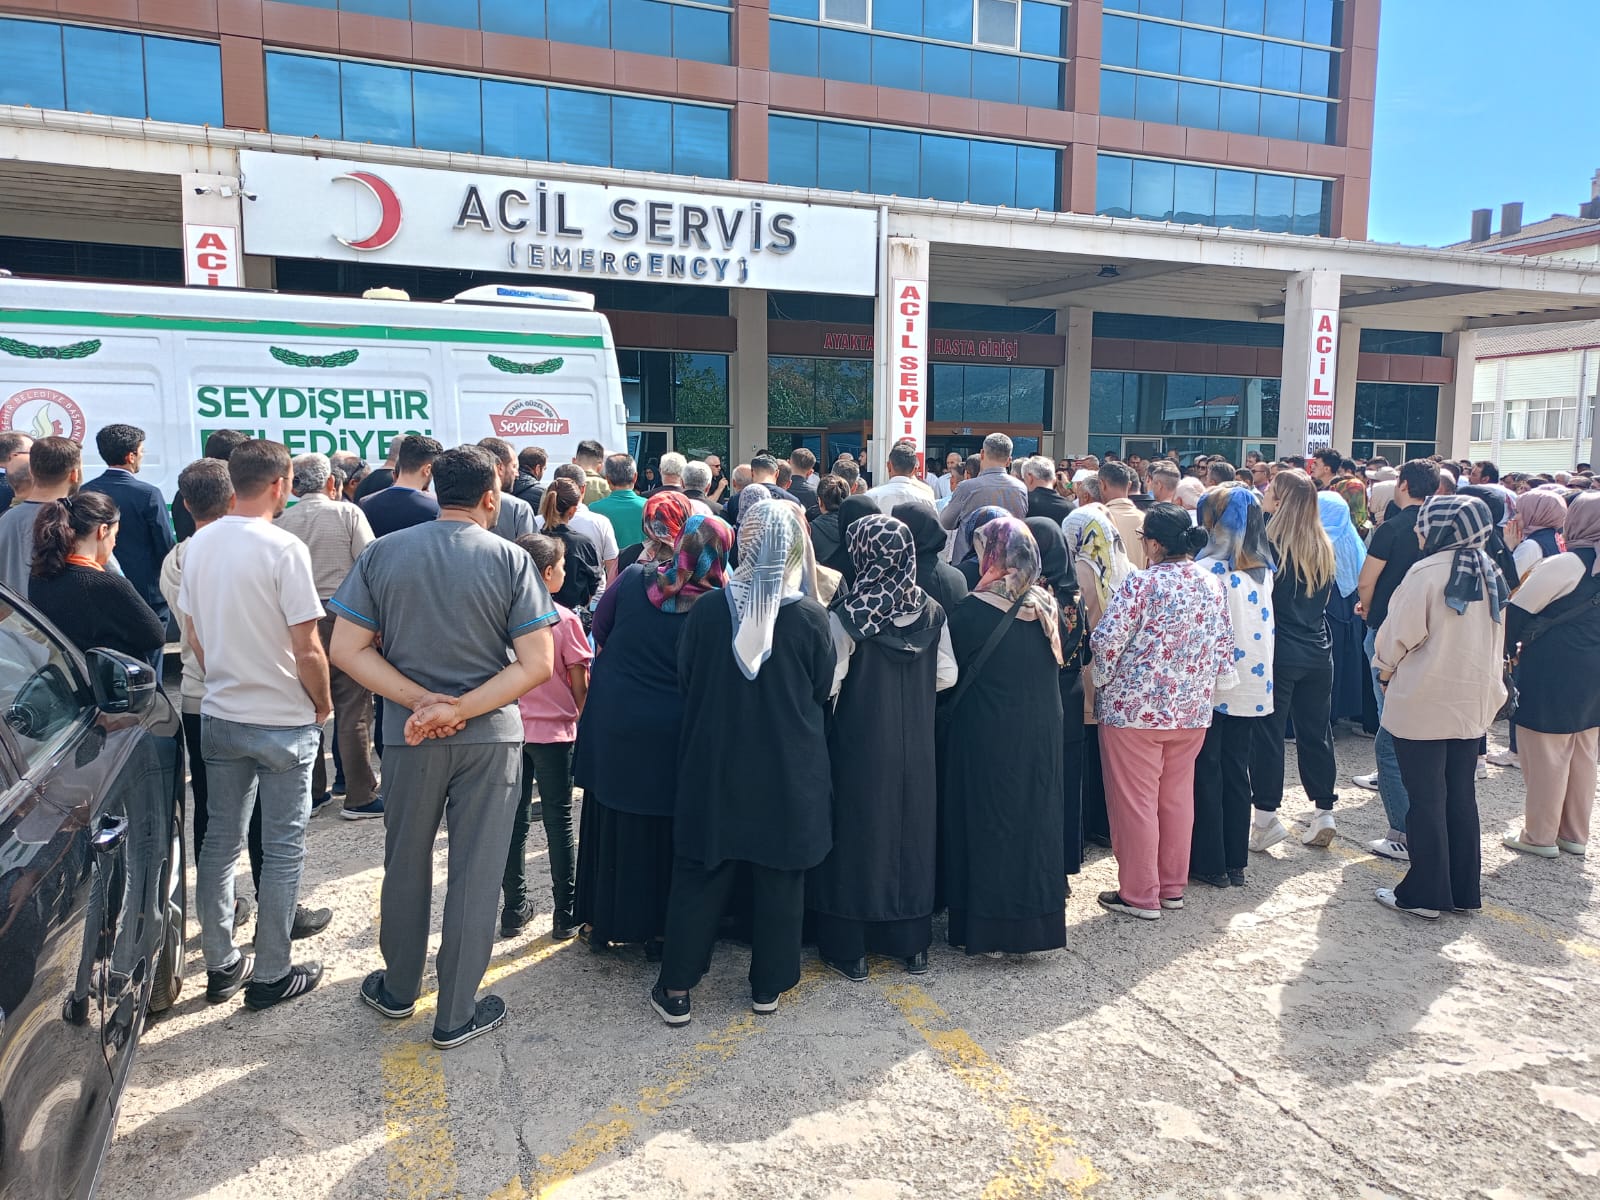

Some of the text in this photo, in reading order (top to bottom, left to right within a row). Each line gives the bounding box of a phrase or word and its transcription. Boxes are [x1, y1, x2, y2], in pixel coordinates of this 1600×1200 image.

[453, 181, 797, 255] ACİL SERVİS
[195, 232, 227, 286] ACİ
[508, 241, 748, 283] (EMERGENCY)
[934, 338, 976, 356] HASTA
[197, 385, 430, 425] SEYDİŞEHİR
[508, 401, 524, 415] DAHA
[499, 419, 564, 435] Seydişehir
[1308, 422, 1330, 435] HASTA
